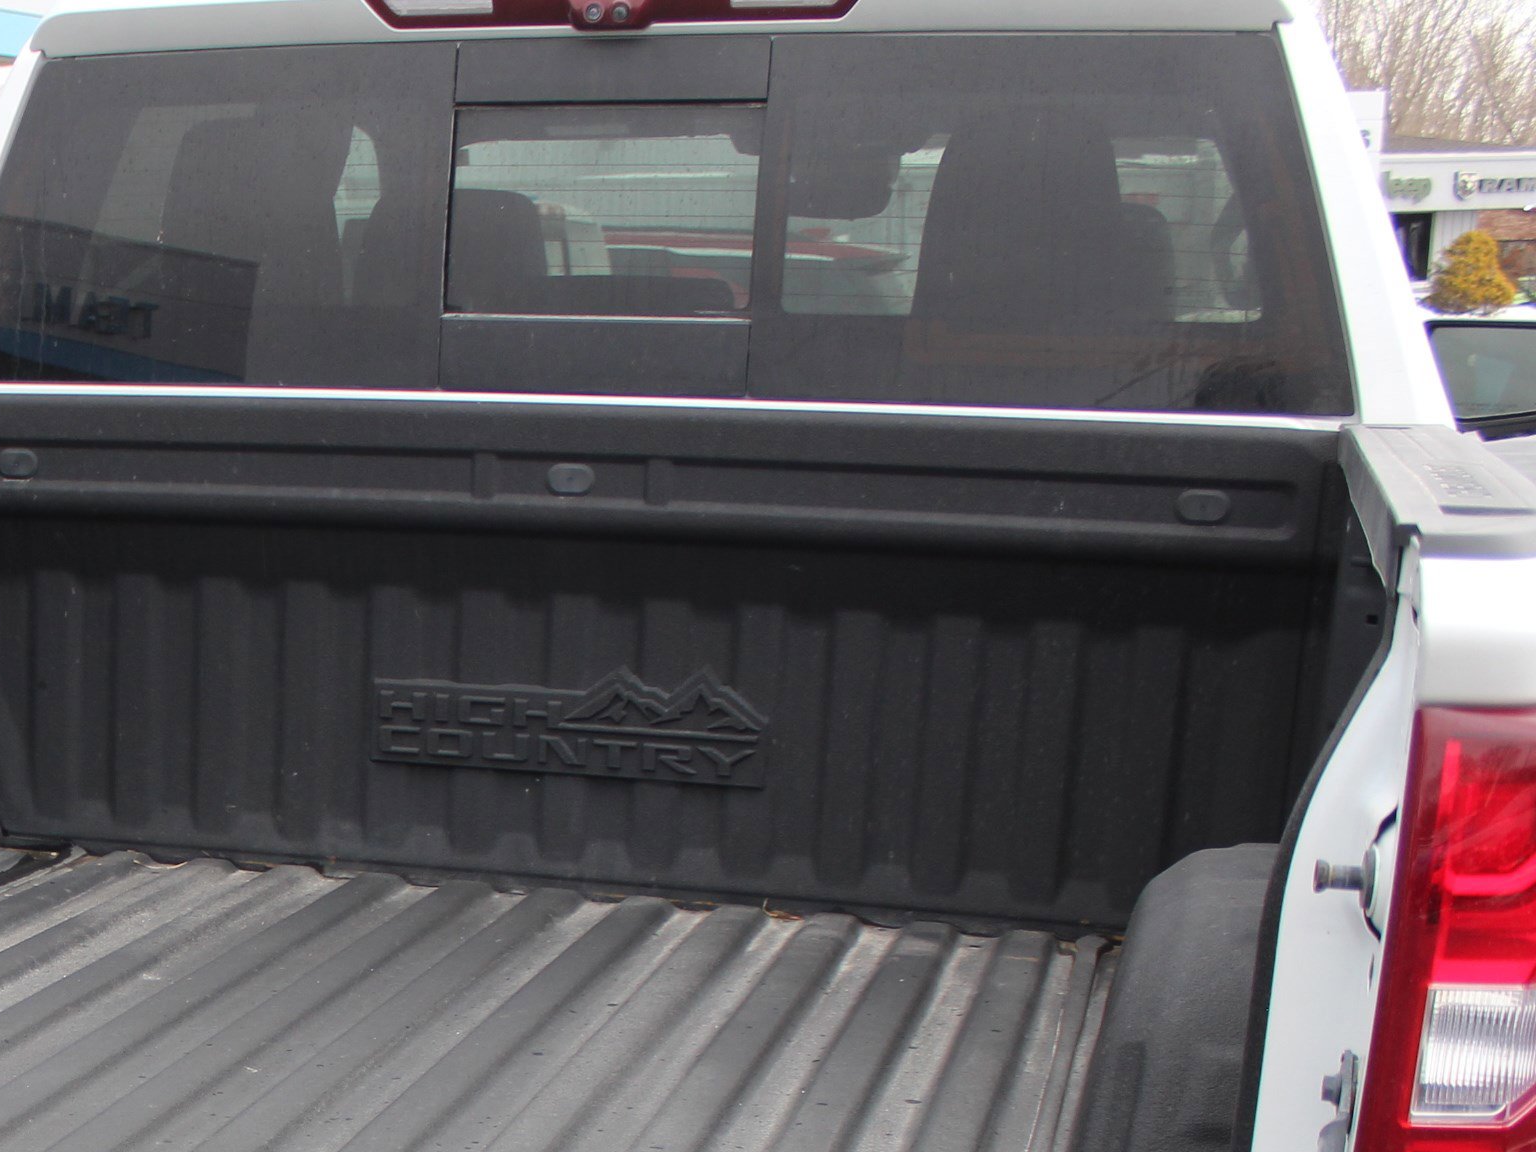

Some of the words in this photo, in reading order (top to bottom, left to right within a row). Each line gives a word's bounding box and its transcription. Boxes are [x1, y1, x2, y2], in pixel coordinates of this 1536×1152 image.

[1478, 177, 1536, 193] RAM
[378, 689, 563, 728] HIGH
[377, 726, 756, 776] COUNTRY
